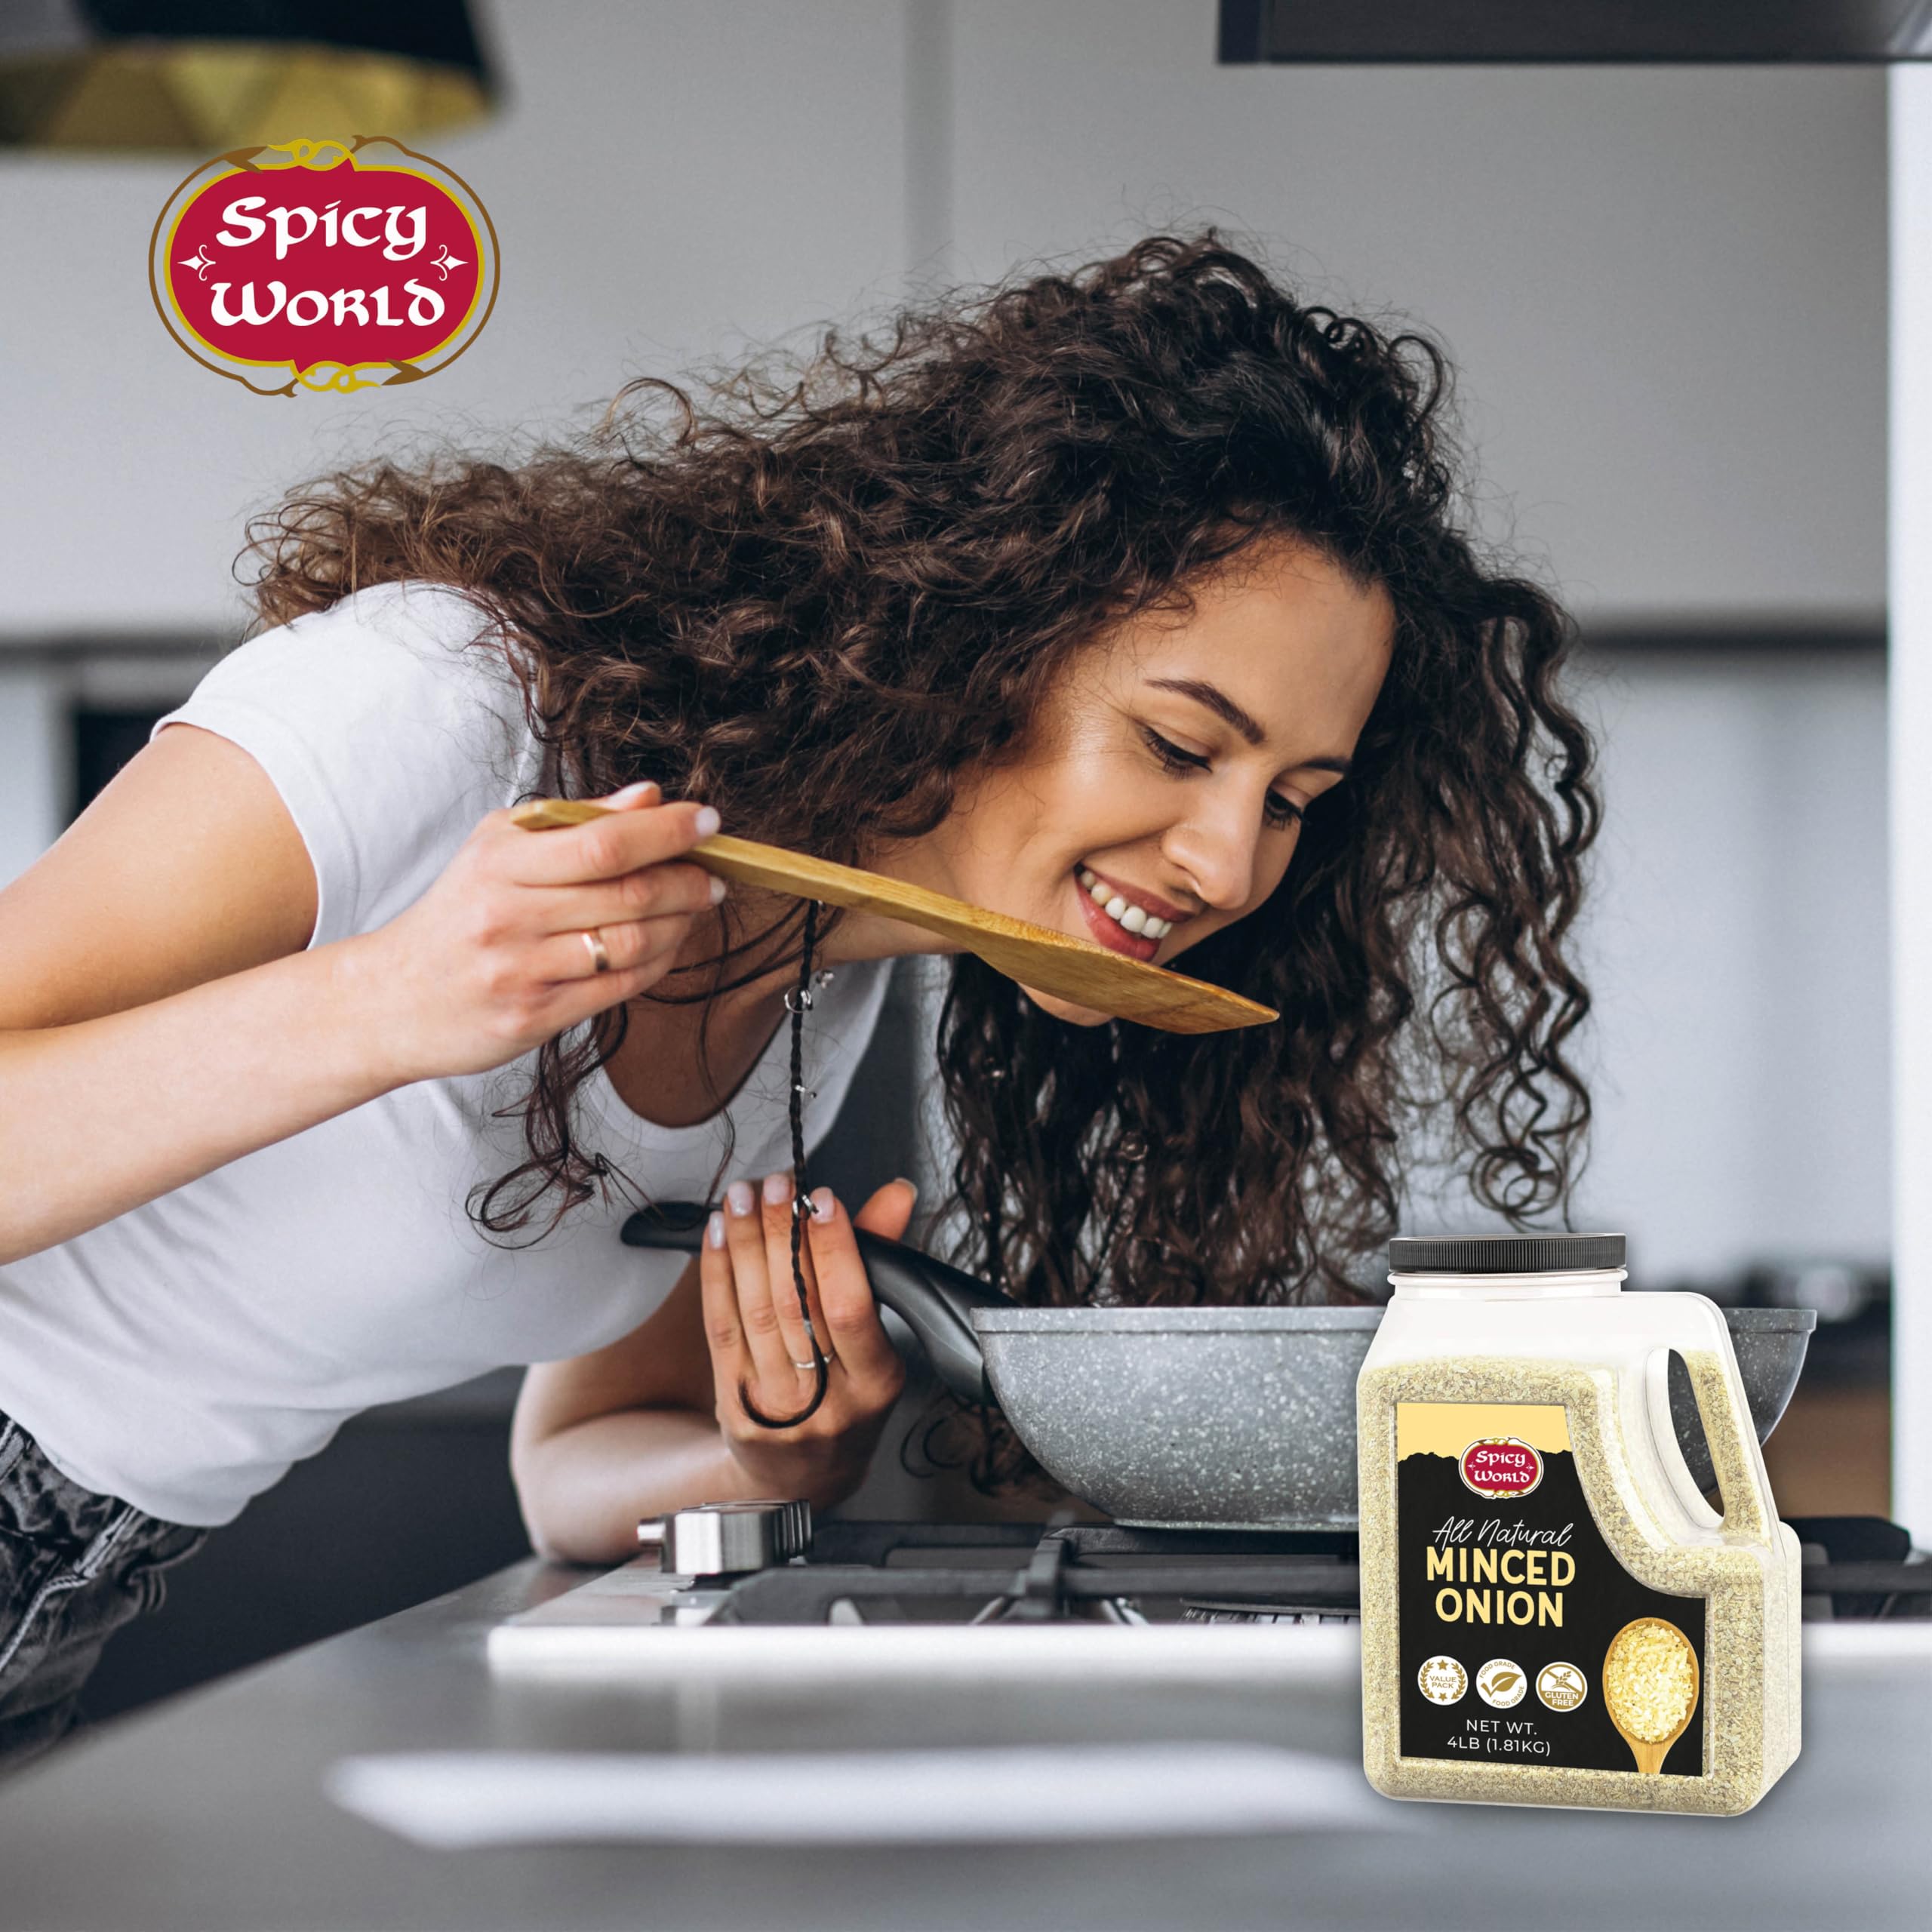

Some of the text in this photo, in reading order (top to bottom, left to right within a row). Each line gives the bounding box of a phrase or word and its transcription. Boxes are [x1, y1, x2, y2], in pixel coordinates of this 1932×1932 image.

[1475, 1450, 1526, 1467] Spicy
[1432, 1516, 1574, 1552] All Natural
[1426, 1546, 1576, 1586] MINCED
[1435, 1588, 1564, 1627] ONION
[1479, 1661, 1515, 1678] FOOD GRADE
[1511, 1685, 1524, 1704] GRADE
[1545, 1691, 1579, 1700] GLUTEN
[1552, 1698, 1574, 1706] FREE
[1466, 1719, 1537, 1735] NET WT.
[1447, 1736, 1551, 1757] 4LB (1.81KG)
